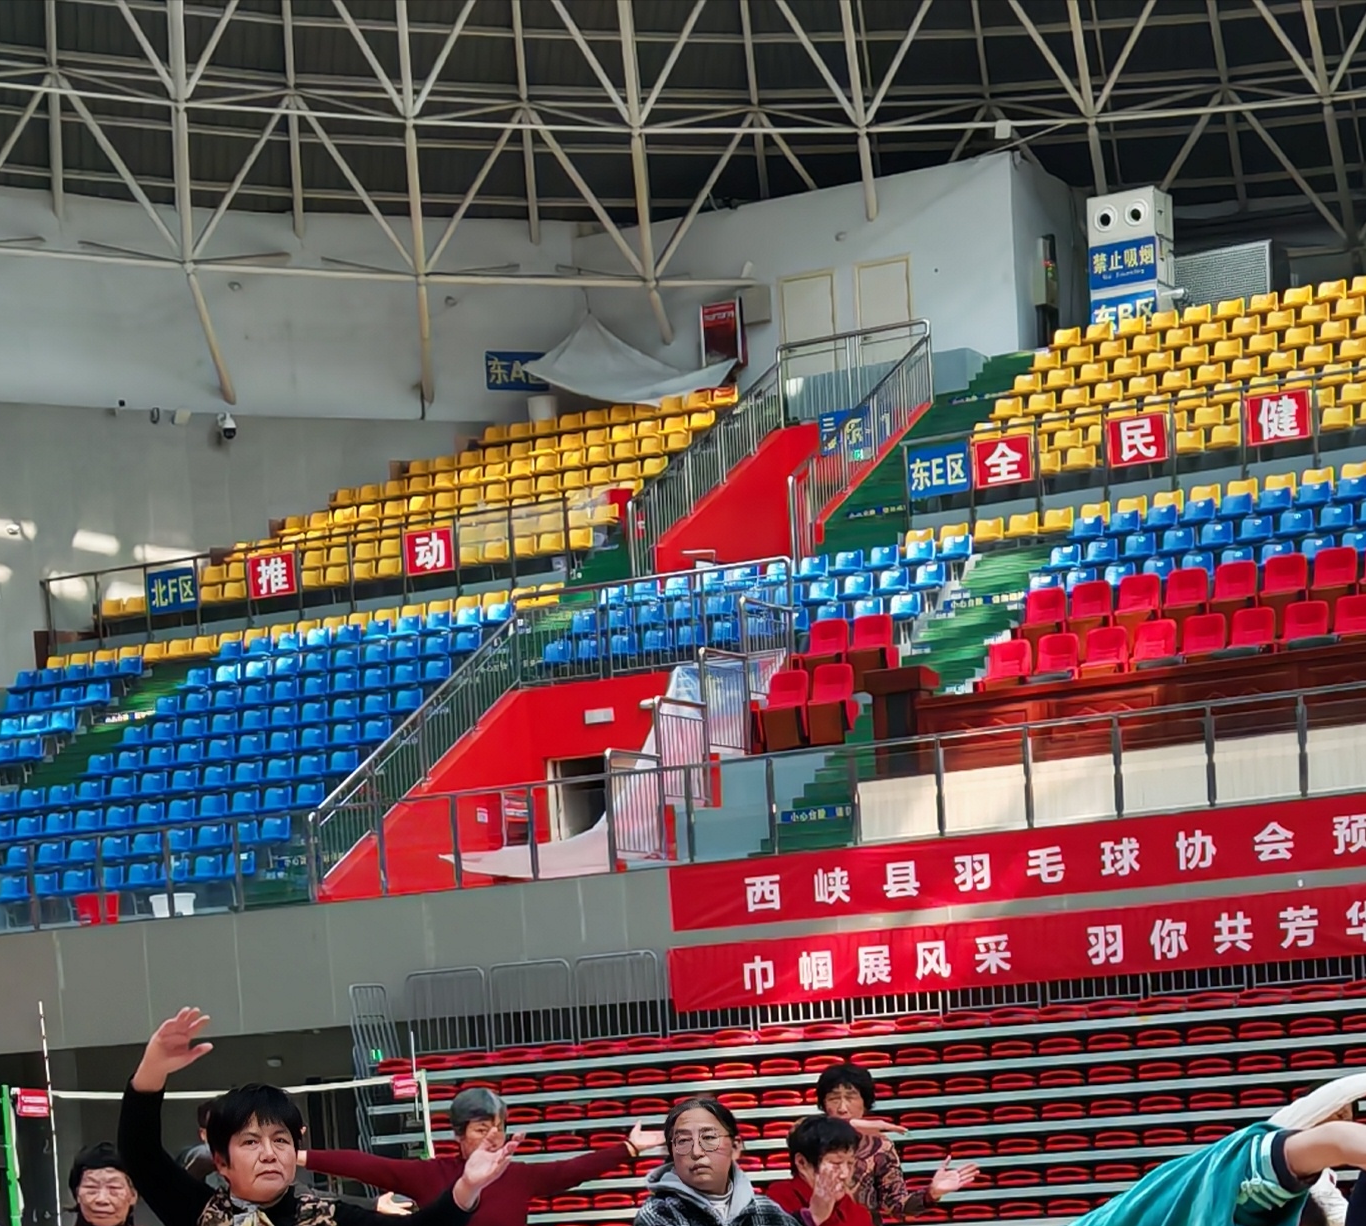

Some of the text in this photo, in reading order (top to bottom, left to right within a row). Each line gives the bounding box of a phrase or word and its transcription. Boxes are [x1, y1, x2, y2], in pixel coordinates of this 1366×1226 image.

[1093, 244, 1155, 274] 禁止吸烟
[1258, 396, 1301, 440] 健
[1120, 418, 1157, 462] 民
[910, 453, 967, 491] 东E区
[985, 442, 1022, 483] 全
[415, 532, 446, 570] 动
[151, 575, 196, 608] 北F区
[257, 559, 290, 595] 推
[743, 934, 1012, 995] 巾帼展风采
